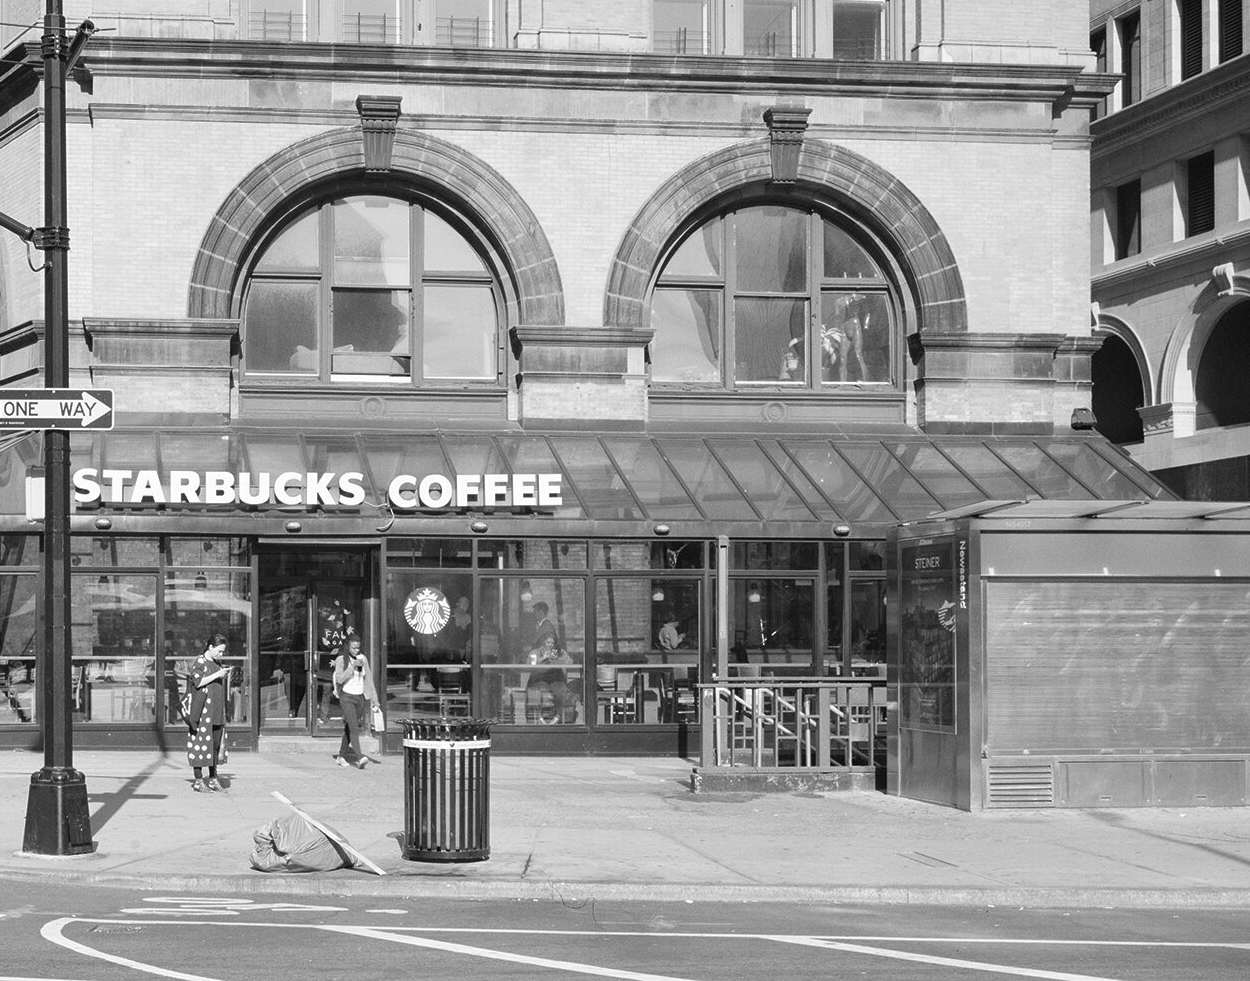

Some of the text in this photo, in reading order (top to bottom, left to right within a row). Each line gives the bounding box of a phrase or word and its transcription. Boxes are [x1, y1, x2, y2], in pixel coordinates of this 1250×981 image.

[3, 401, 97, 417] ONE WAY
[71, 467, 563, 508] STARBUCKS COFFEE
[914, 556, 941, 570] STEINER
[959, 540, 967, 609] Newsstand
